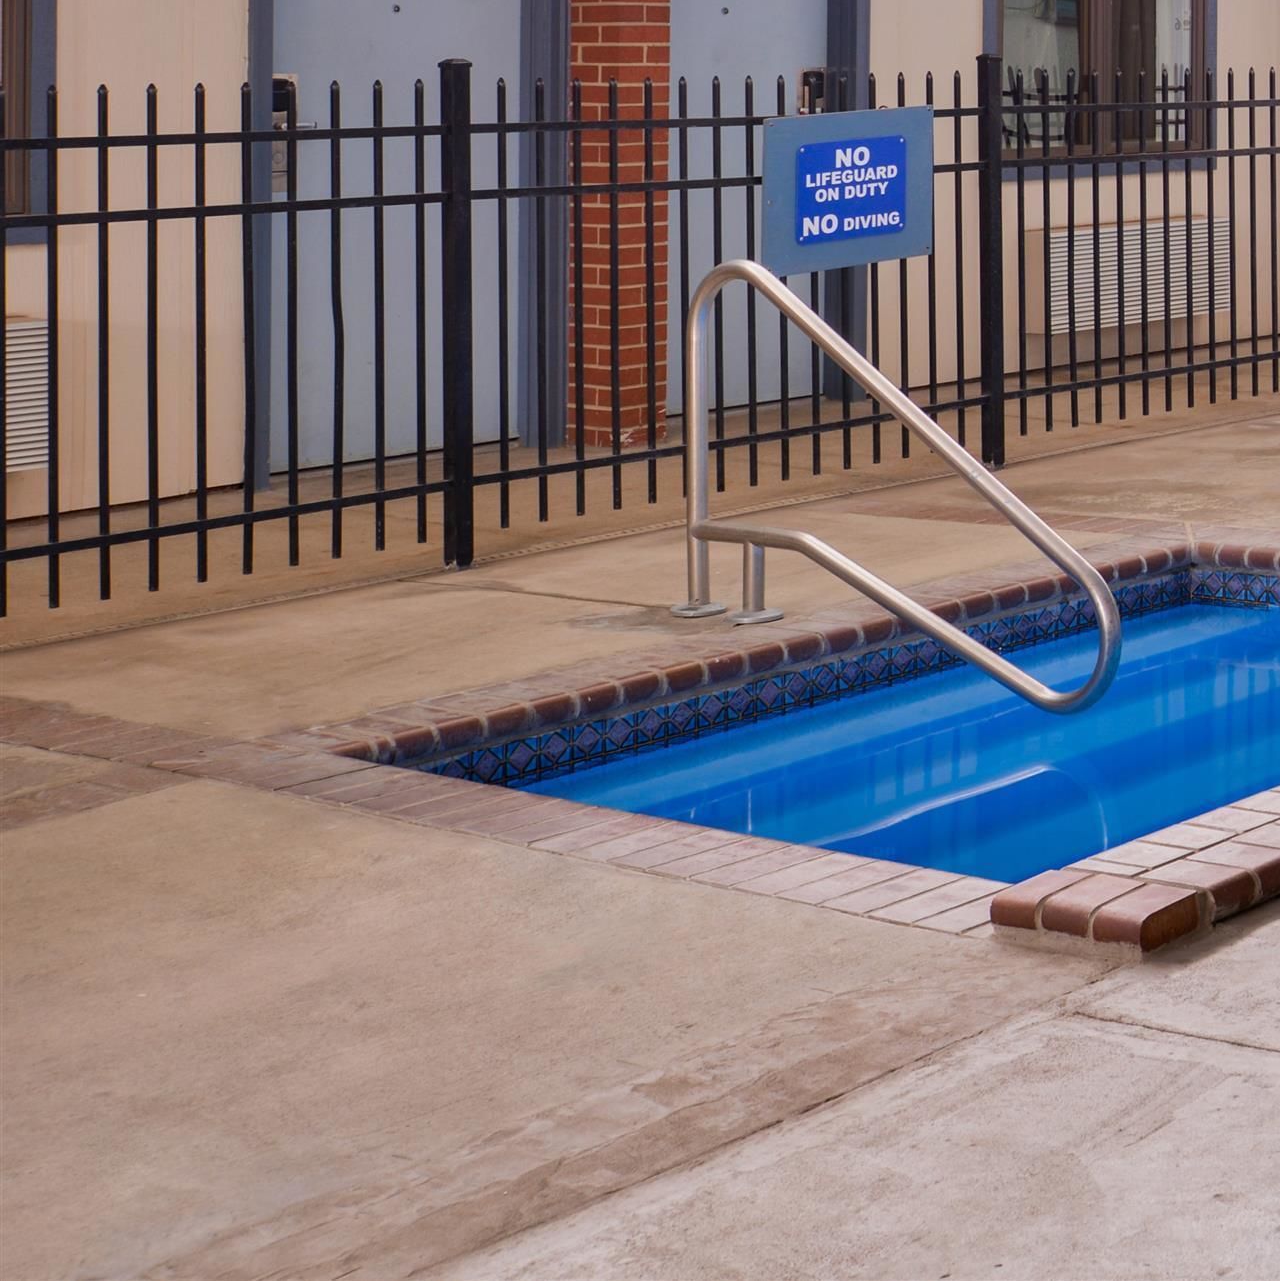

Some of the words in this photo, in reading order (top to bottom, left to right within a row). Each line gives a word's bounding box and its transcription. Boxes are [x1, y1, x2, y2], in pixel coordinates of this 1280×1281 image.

[835, 146, 870, 168] NO
[805, 165, 898, 188] LIFEGUARD
[815, 187, 840, 203] ON
[844, 181, 889, 200] DUTY
[802, 214, 839, 237] NO
[843, 211, 900, 232] DIVING
